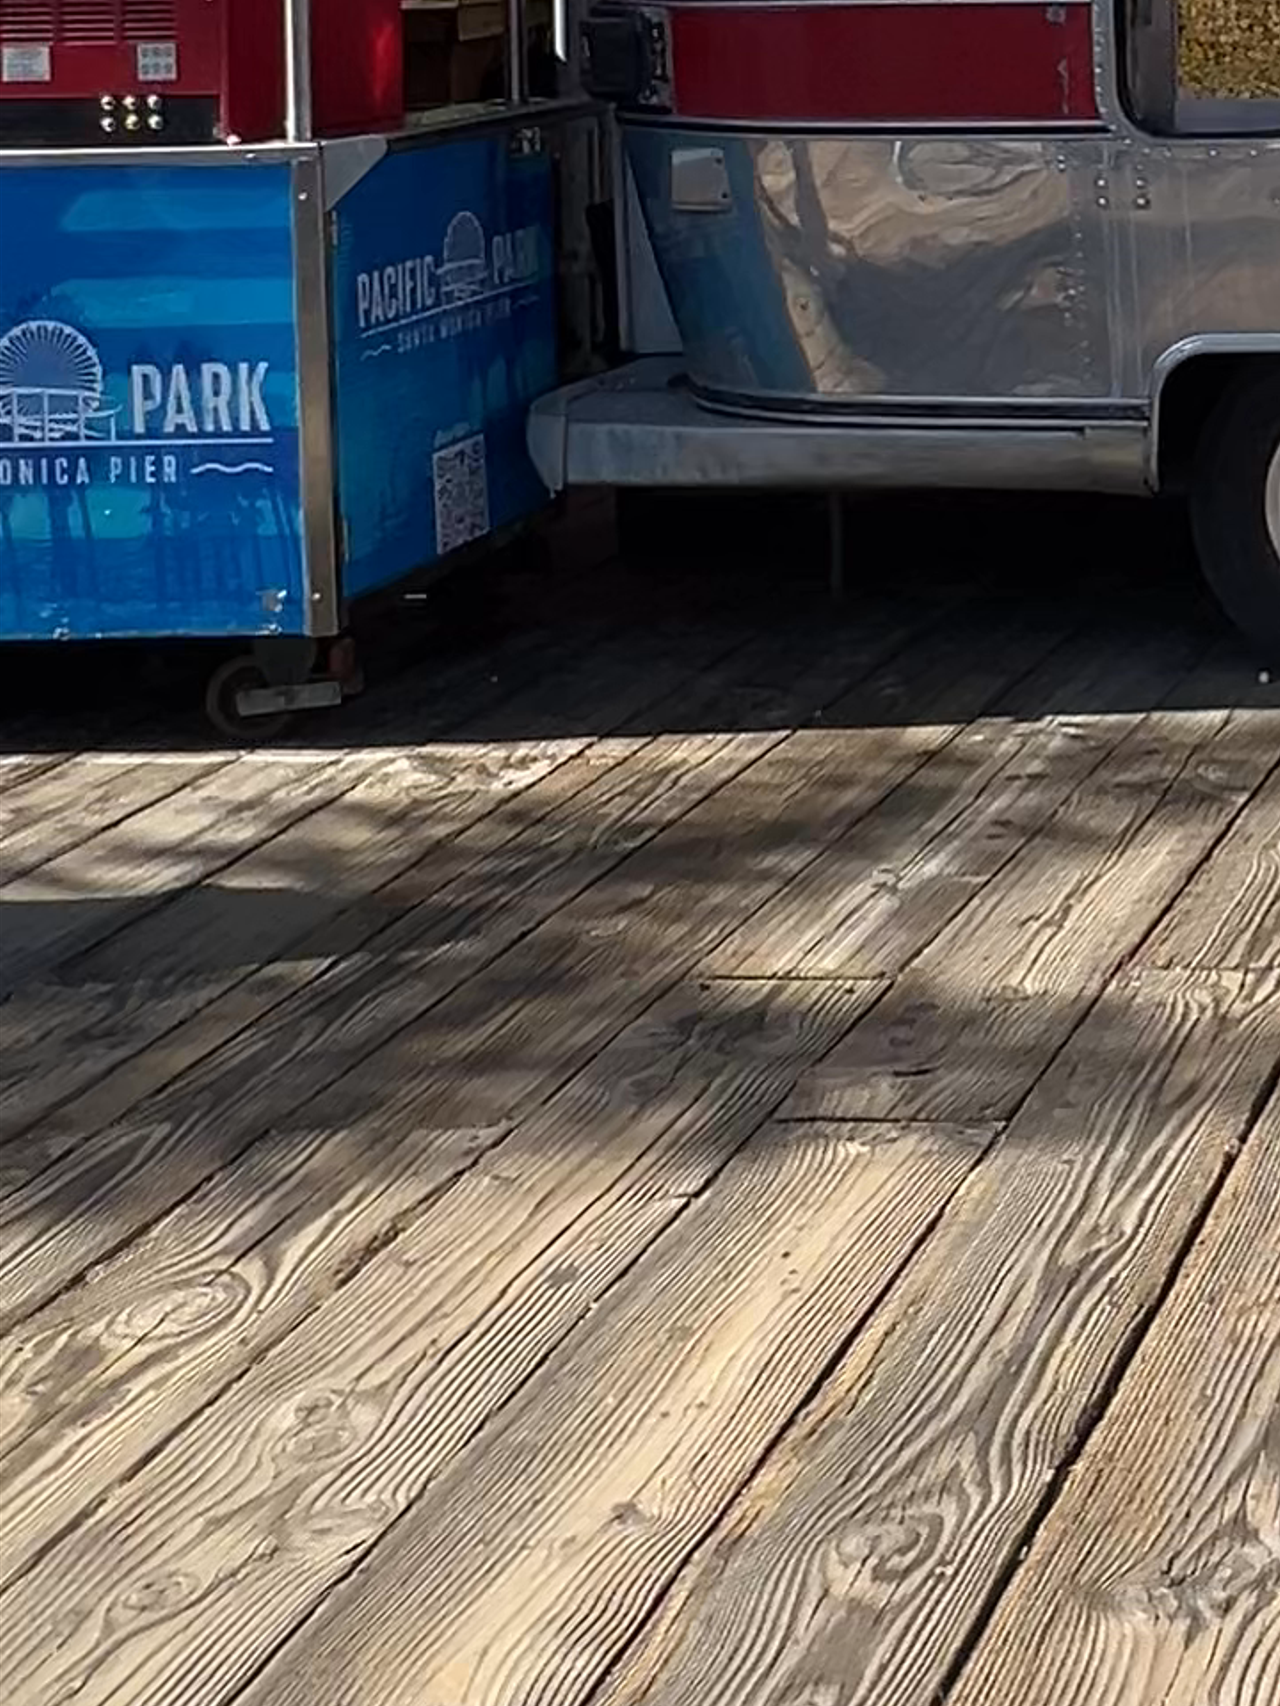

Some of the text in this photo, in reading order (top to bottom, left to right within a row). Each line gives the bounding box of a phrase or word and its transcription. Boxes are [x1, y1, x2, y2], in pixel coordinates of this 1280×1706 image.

[356, 255, 437, 329] PACIFIC
[131, 361, 271, 434] PARK
[110, 455, 177, 484] PIER
